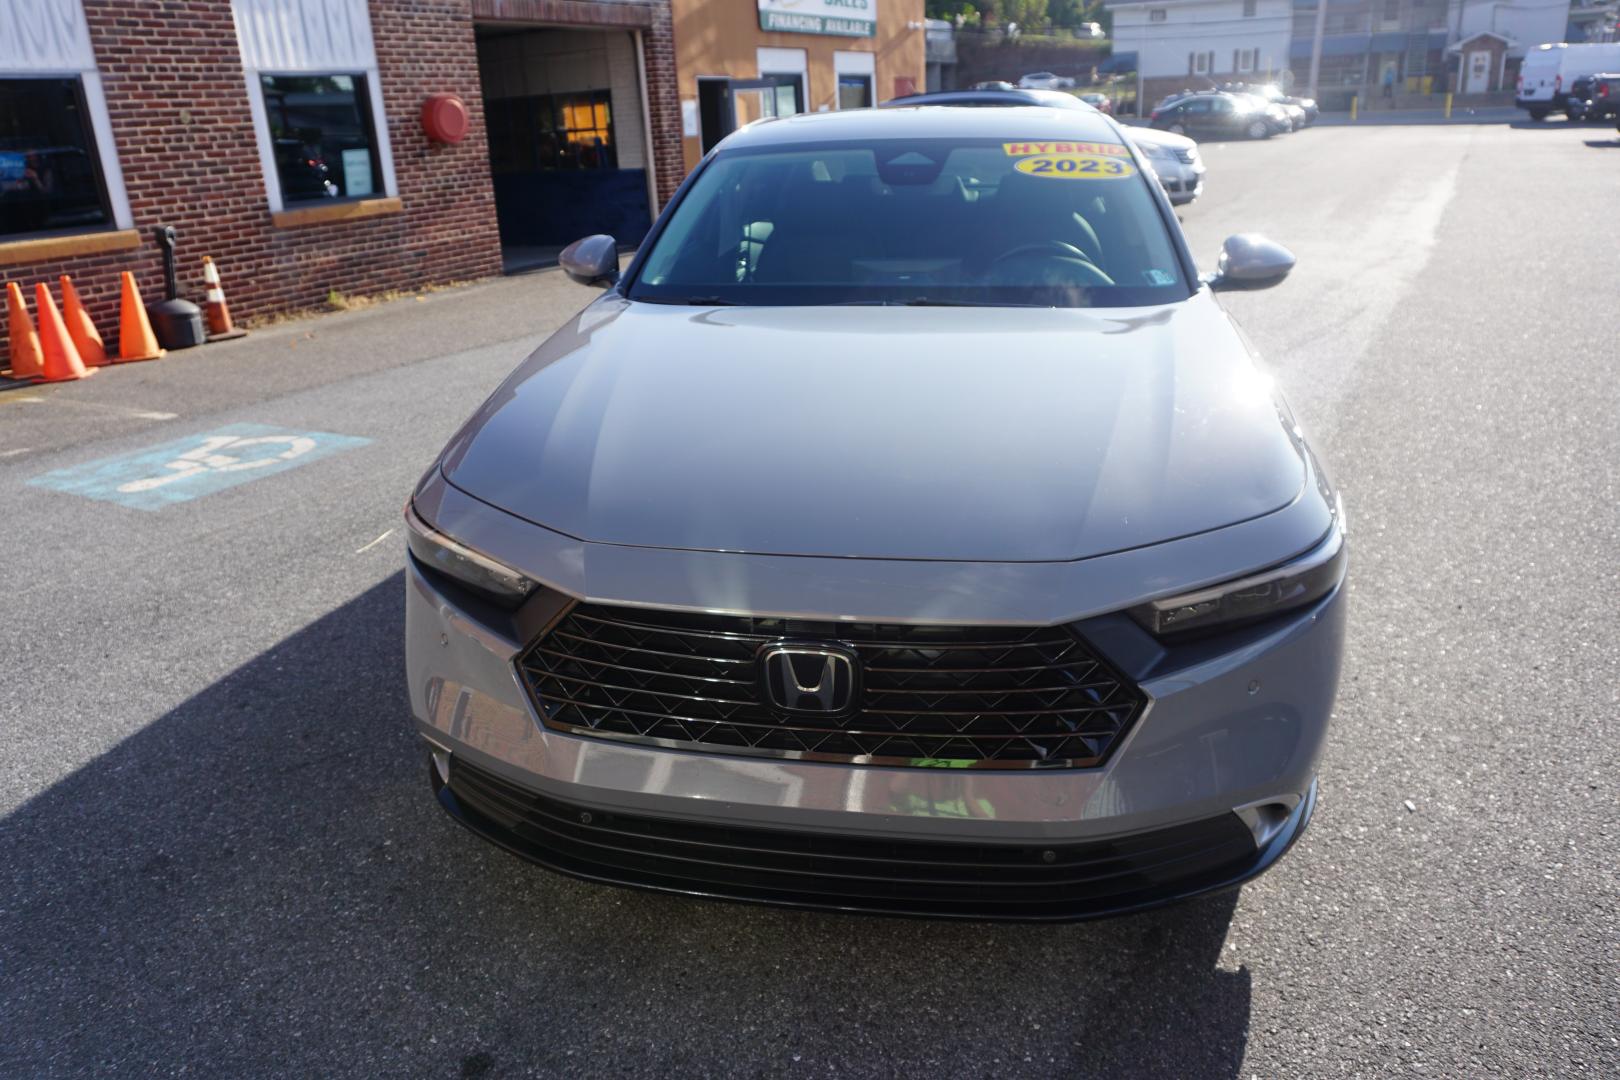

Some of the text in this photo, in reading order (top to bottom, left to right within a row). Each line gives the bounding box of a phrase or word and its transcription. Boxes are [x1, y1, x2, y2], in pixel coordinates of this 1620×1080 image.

[768, 13, 870, 35] FINANCING AVAILABLE
[1009, 143, 1126, 155] HYBRID
[1032, 159, 1124, 174] 2023
